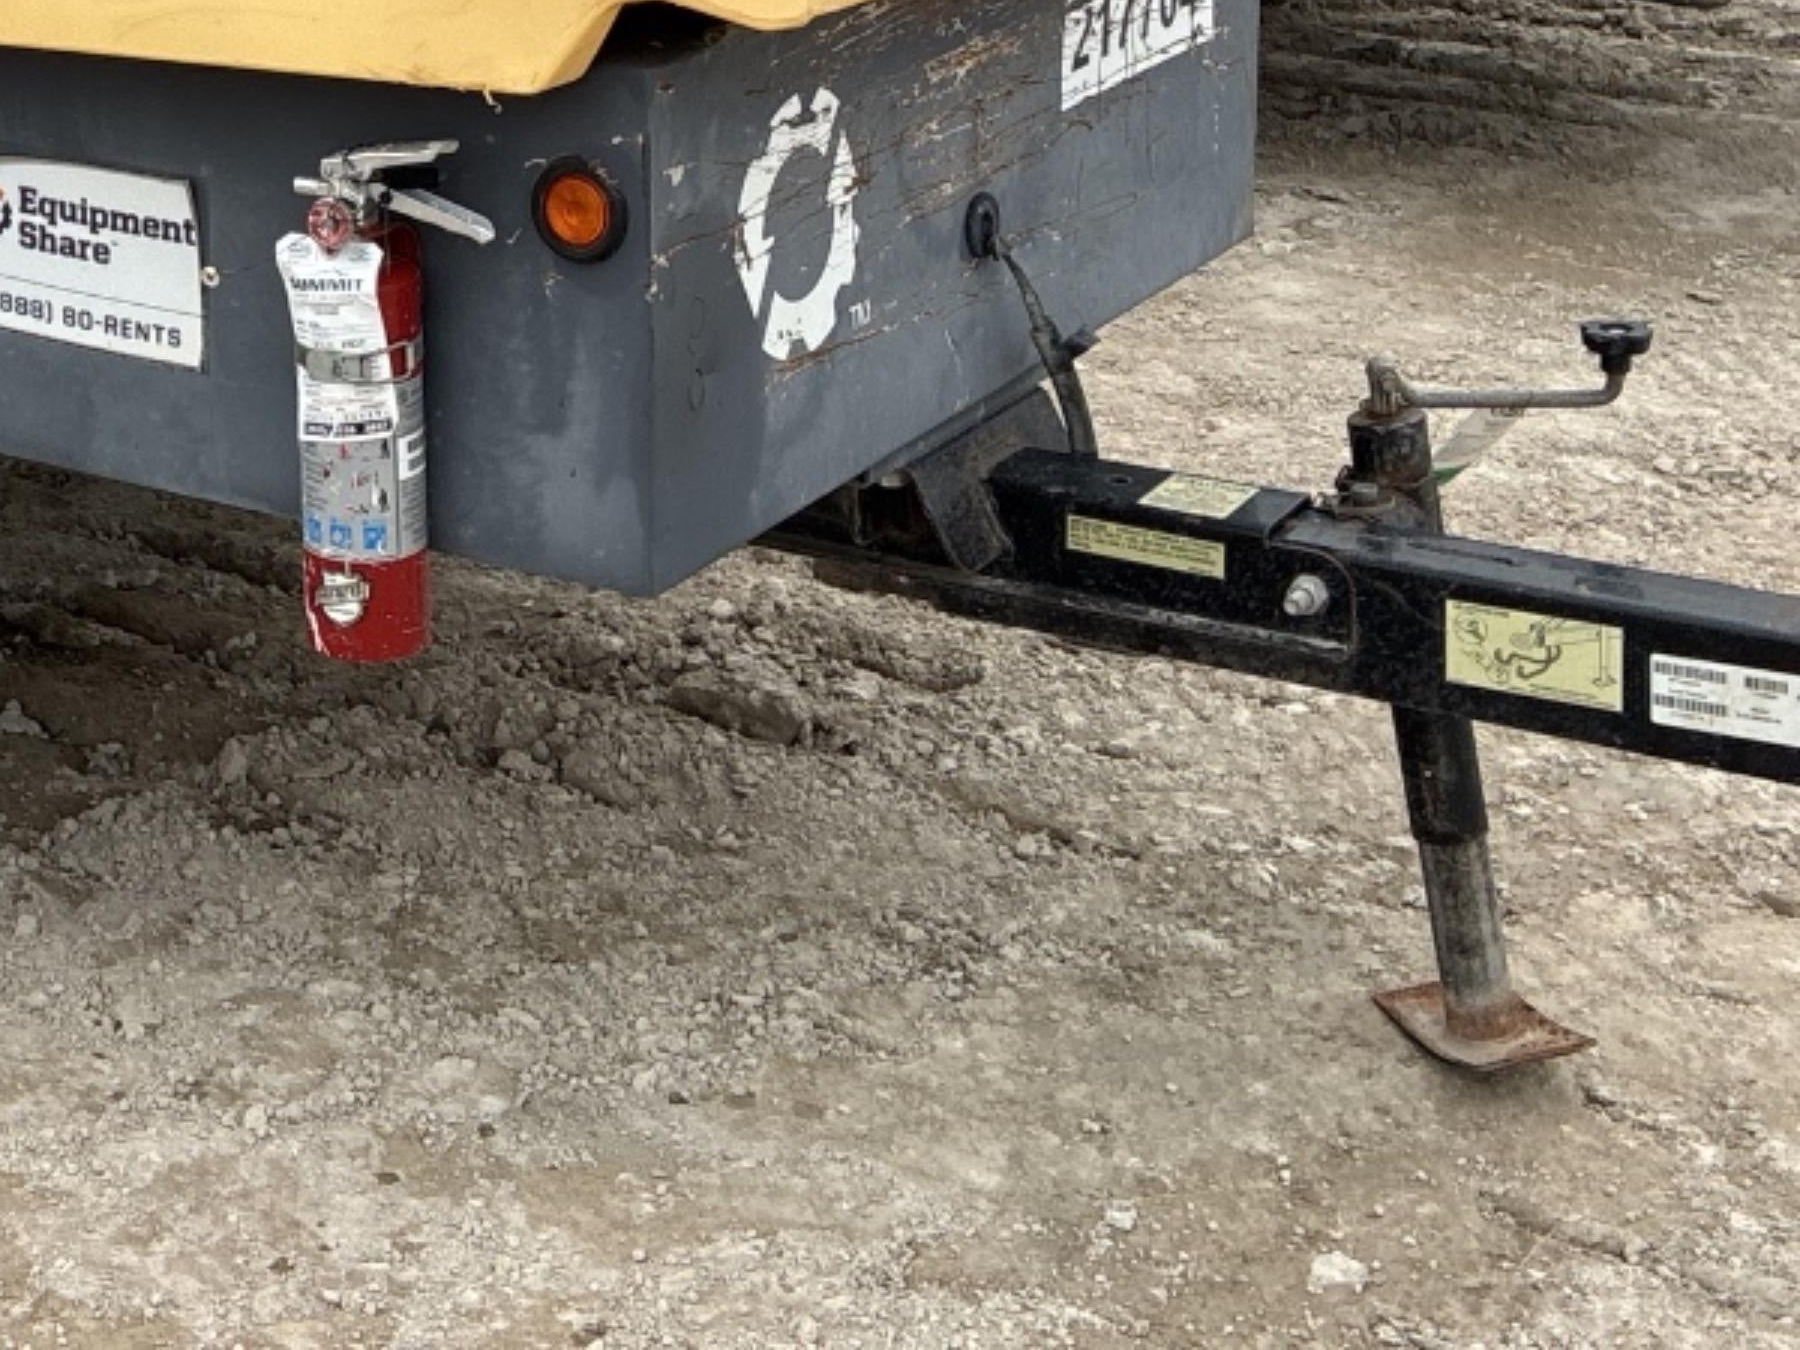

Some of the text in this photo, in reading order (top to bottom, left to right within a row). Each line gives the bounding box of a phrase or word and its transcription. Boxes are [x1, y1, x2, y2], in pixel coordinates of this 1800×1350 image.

[17, 185, 198, 247] Equipment
[18, 221, 112, 265] Share
[61, 305, 182, 349] 80-RENTS
